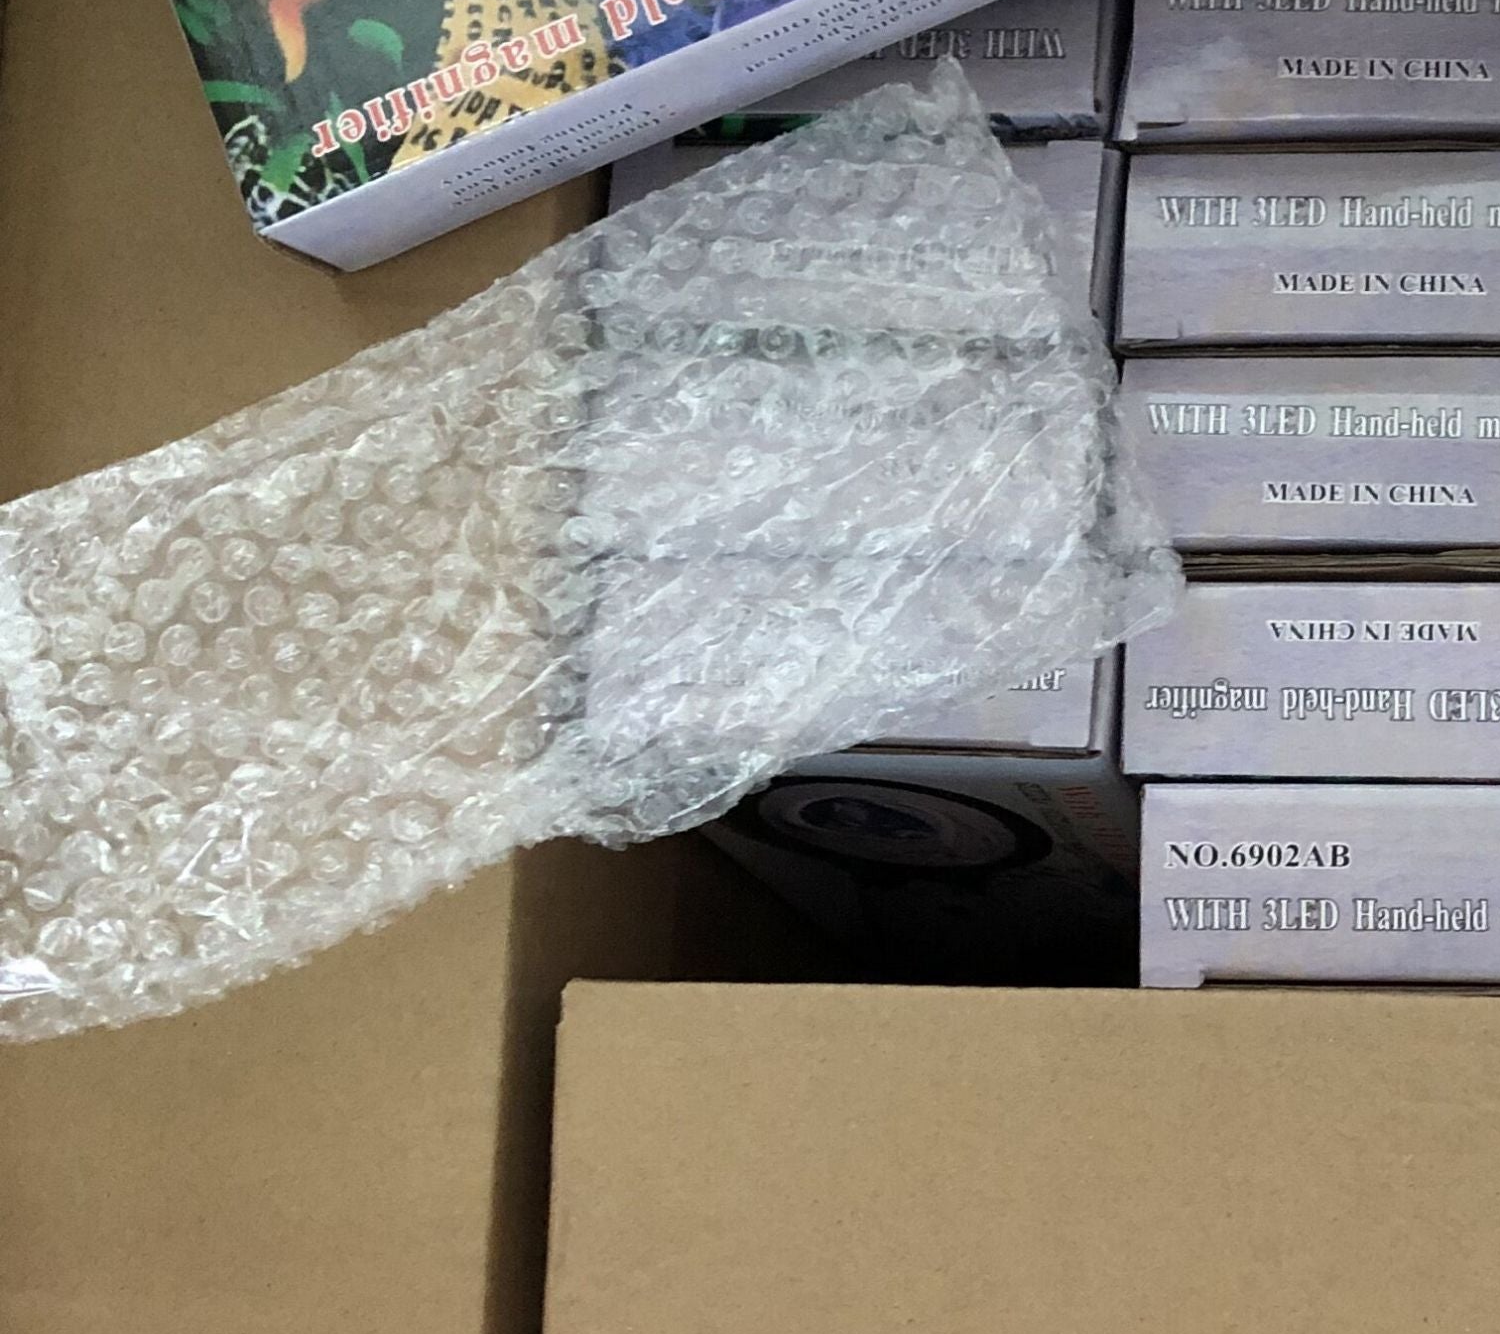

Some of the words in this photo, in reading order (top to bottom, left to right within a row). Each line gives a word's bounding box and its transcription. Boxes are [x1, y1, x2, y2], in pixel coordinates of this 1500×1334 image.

[983, 28, 1065, 58] WITH
[1280, 58, 1357, 78] MADE
[1367, 59, 1395, 78] IN
[1404, 60, 1491, 81] CHINA
[313, 14, 586, 159] magnifier
[1159, 197, 1240, 227] WITH
[1253, 197, 1326, 228] 3LED
[1341, 198, 1472, 228] Hand-held
[1276, 274, 1355, 293] MADE
[1364, 275, 1391, 293] IN
[1400, 275, 1486, 295] CHINA
[1148, 403, 1228, 435] WITH
[1242, 405, 1316, 436] 3LED
[1331, 407, 1462, 439] Hand-held
[1265, 482, 1343, 503] MADE
[1353, 483, 1380, 503] IN
[1388, 485, 1475, 506] CHINA
[1271, 622, 1355, 639] CHINA
[1364, 622, 1391, 640] IN
[1400, 622, 1477, 641] MADE
[1145, 680, 1267, 719] magnifier
[1281, 687, 1413, 721] Hand-held
[1168, 844, 1351, 868] NO.6902AB
[1165, 897, 1250, 930] WITH
[1262, 899, 1340, 931] 3LED
[1352, 900, 1489, 932] Hand-held
